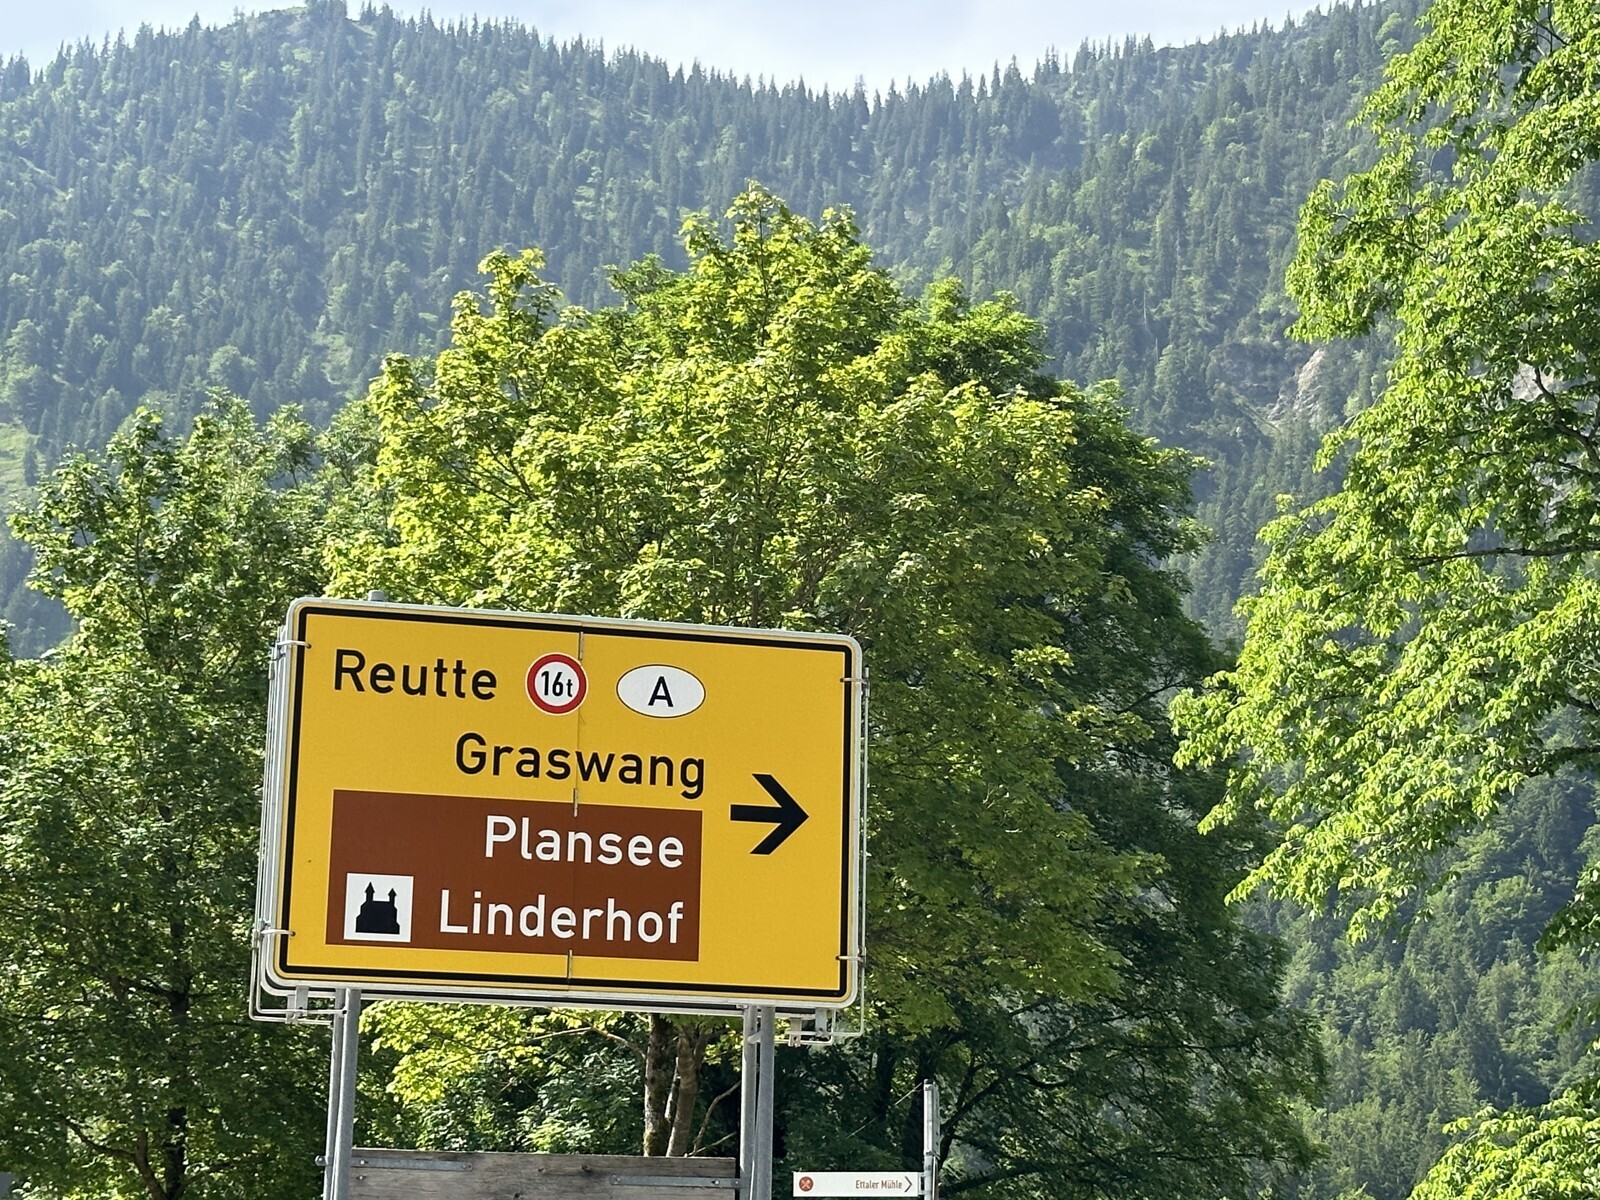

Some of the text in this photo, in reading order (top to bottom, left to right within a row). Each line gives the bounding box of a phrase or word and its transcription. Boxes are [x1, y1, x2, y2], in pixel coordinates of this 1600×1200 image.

[334, 648, 674, 708] Reutte 16t A
[455, 732, 705, 800] Graswang
[485, 815, 684, 868] Plansee
[440, 889, 684, 944] Linderhof
[855, 1179, 902, 1189] Ettaler Mühle
